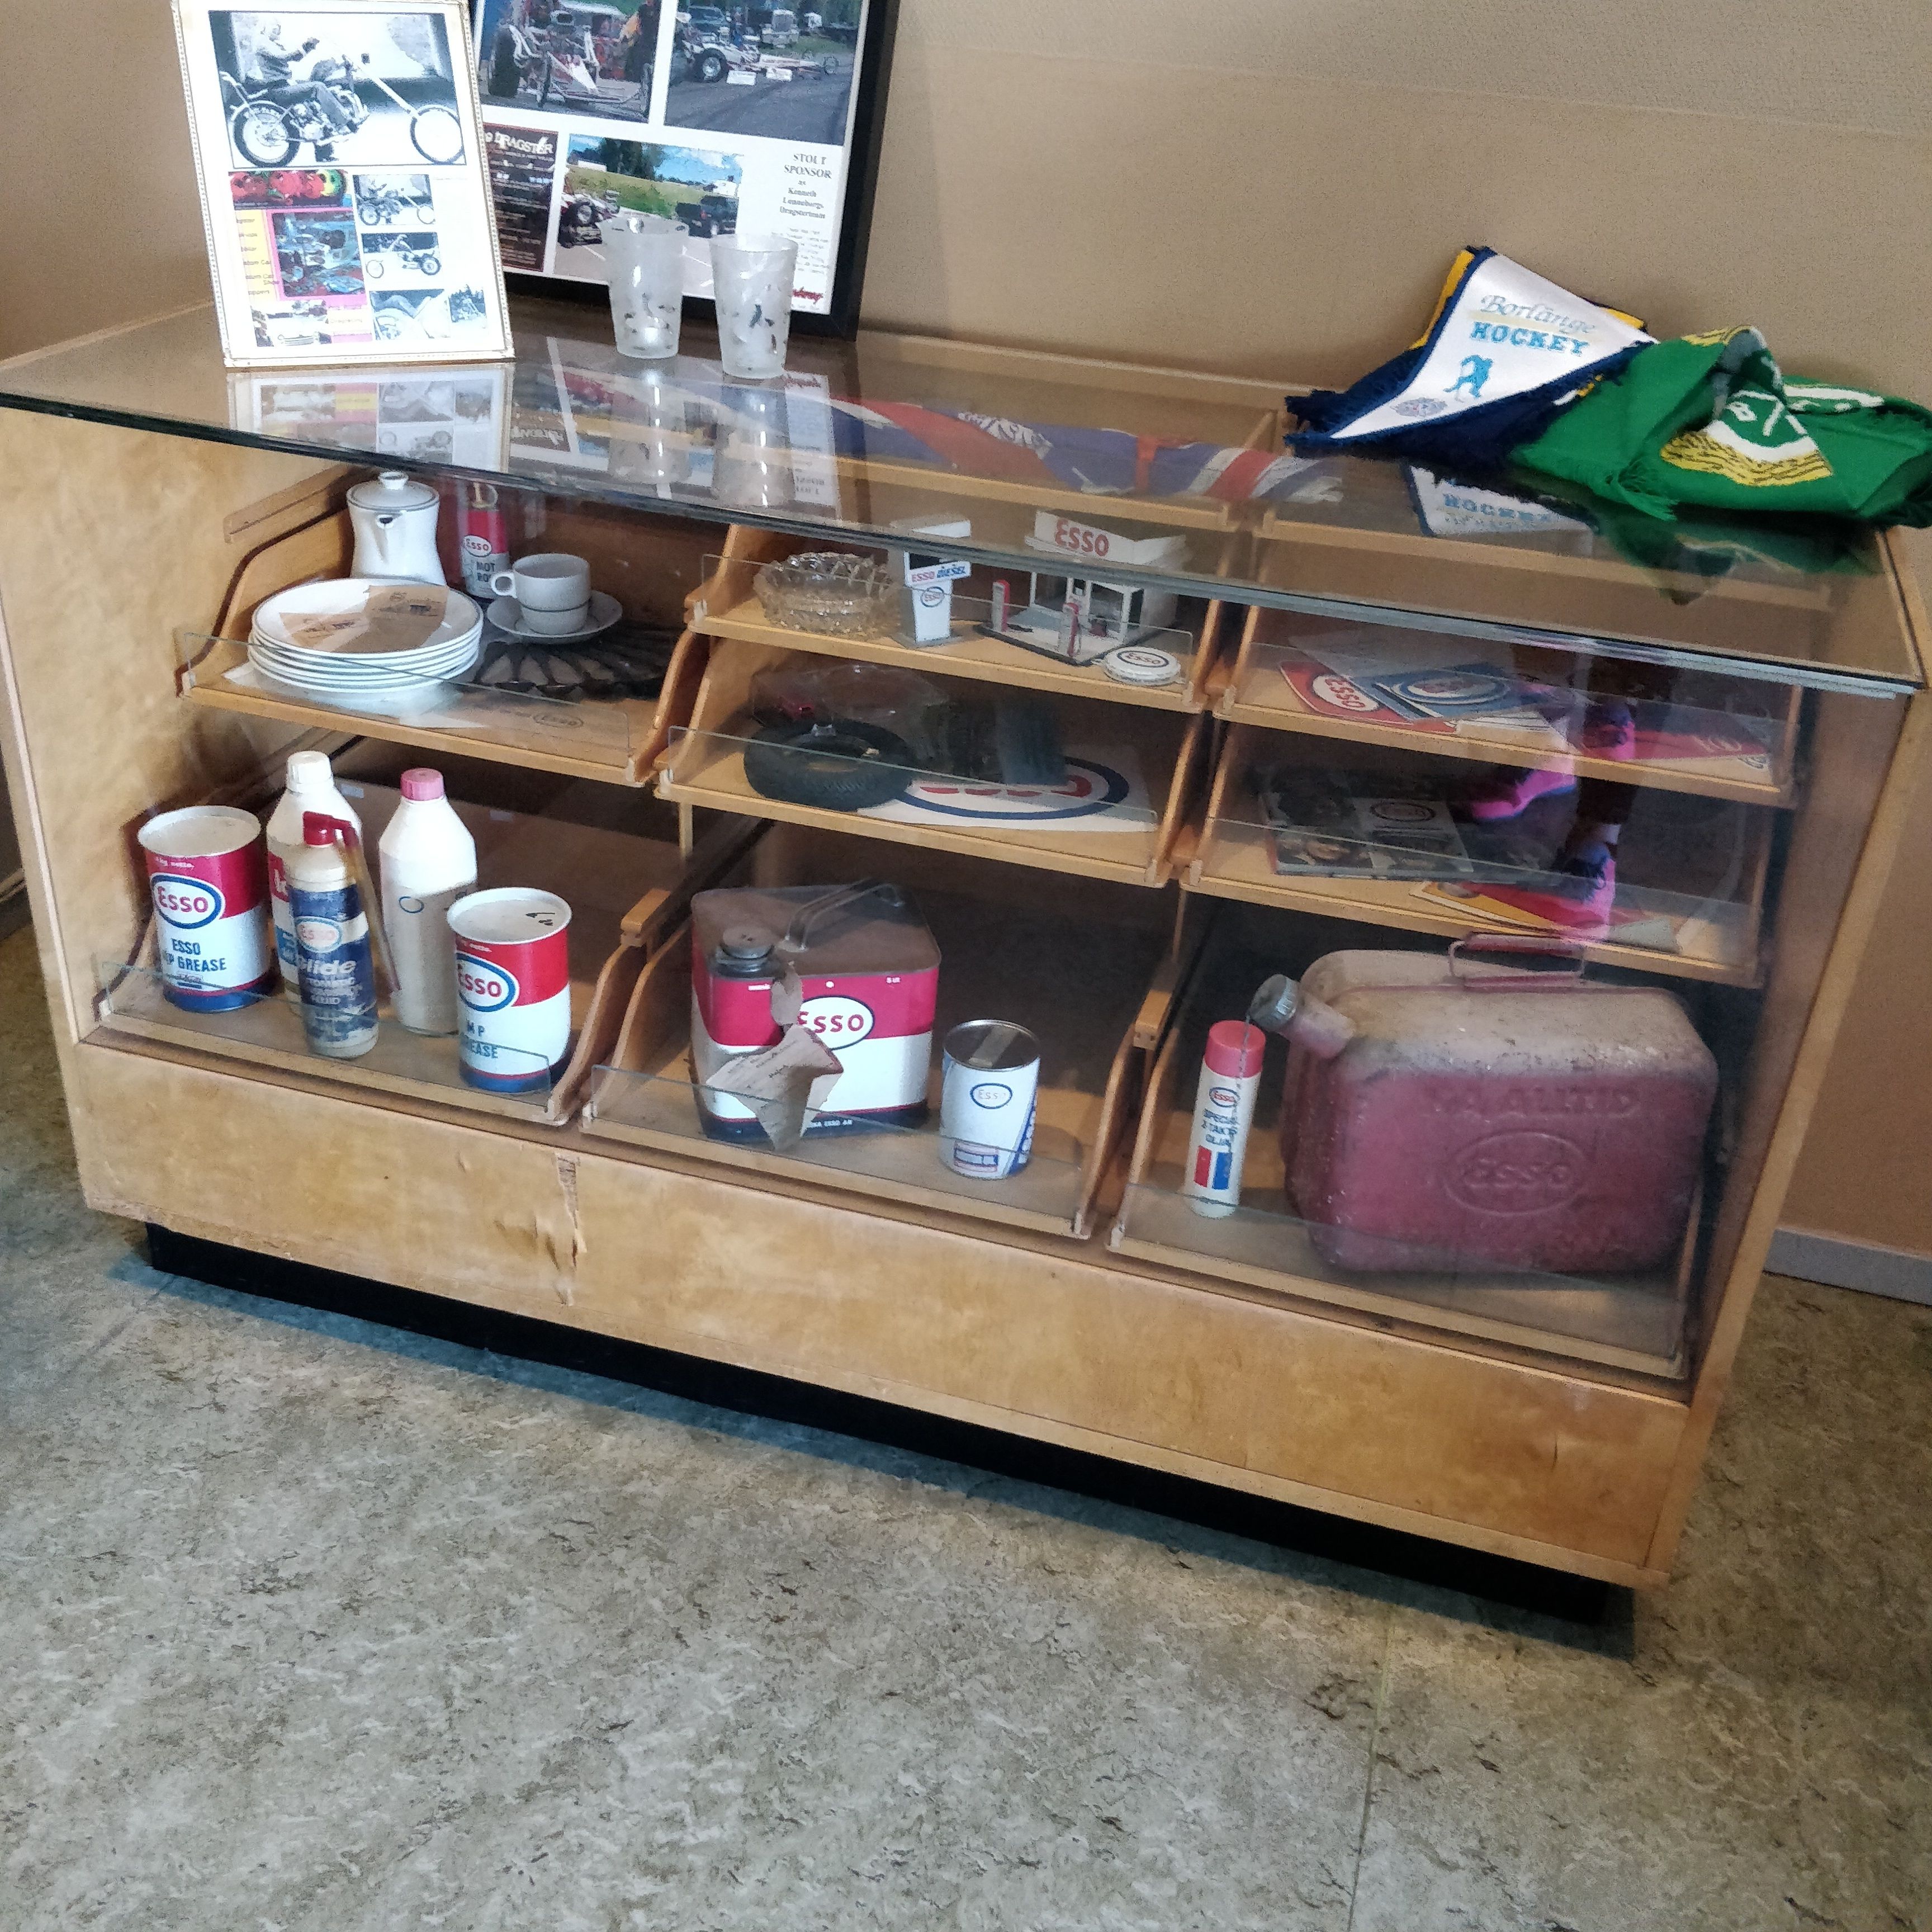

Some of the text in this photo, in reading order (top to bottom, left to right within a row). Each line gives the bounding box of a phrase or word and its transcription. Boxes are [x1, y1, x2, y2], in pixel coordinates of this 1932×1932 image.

[793, 153, 827, 164] STOLT
[784, 164, 832, 179] SPONSOR
[1481, 295, 1595, 334] Borlänge
[1471, 321, 1589, 356] HOCKEY
[466, 538, 489, 551] ESSO
[1054, 518, 1110, 557] ESSO
[1325, 678, 1365, 708] ESSO
[157, 886, 209, 913] ESSO
[171, 938, 201, 955] ESSO
[178, 956, 227, 972] GREASE
[978, 1089, 1006, 1100] ESS
